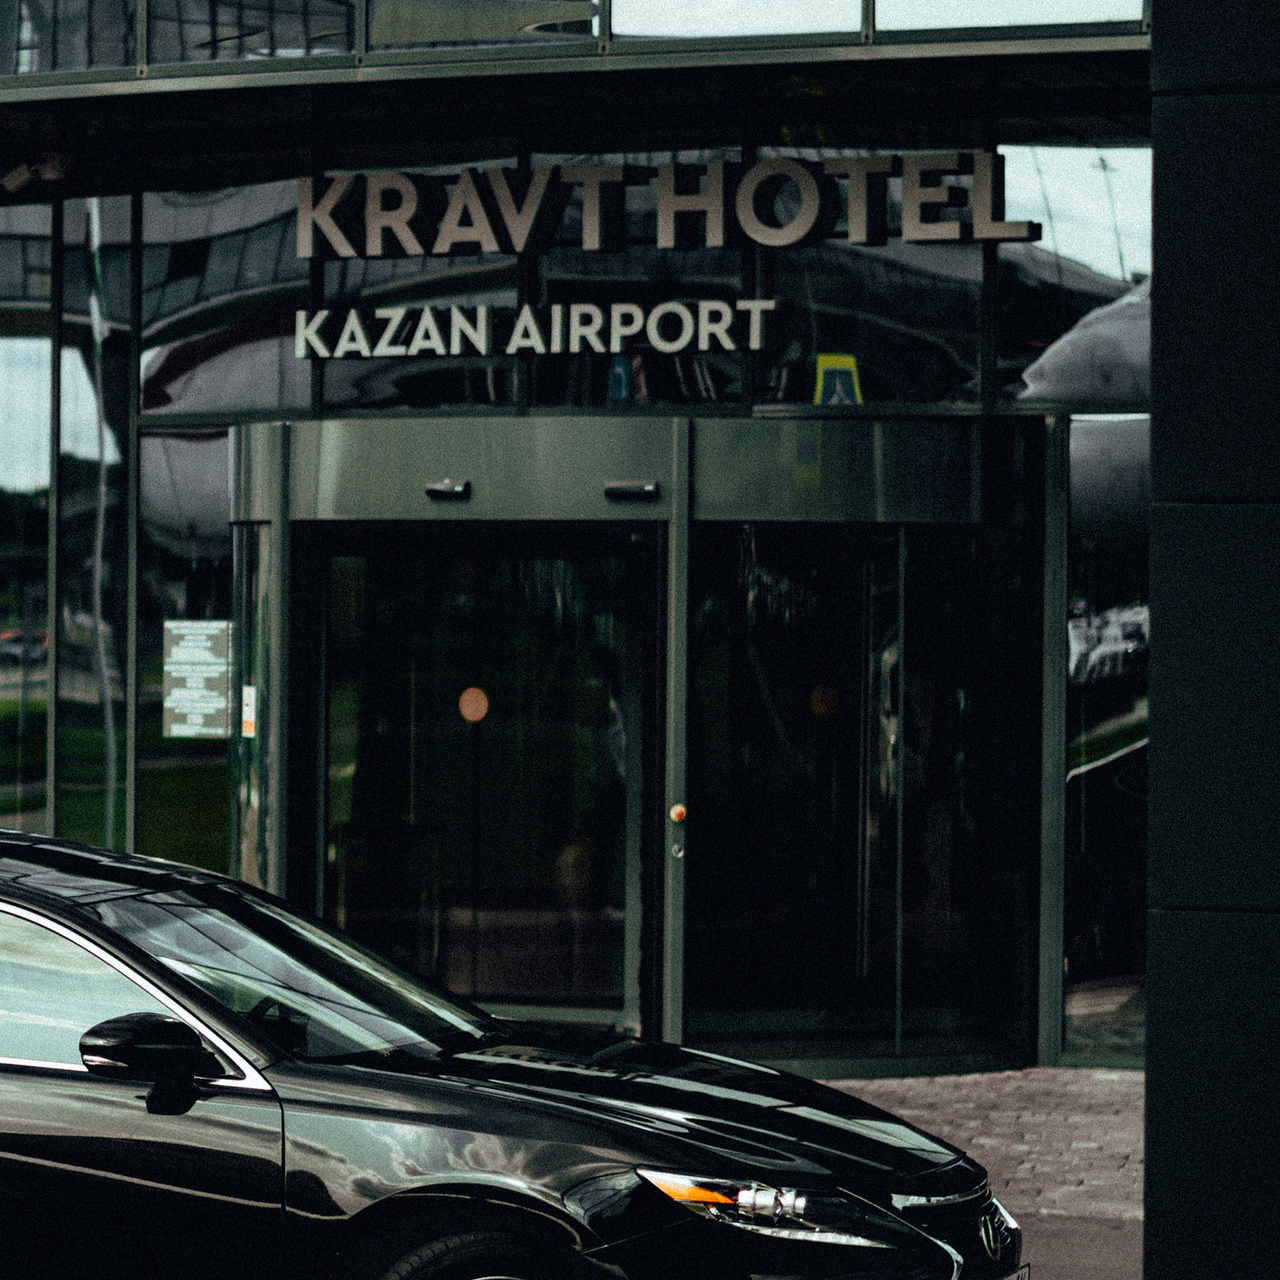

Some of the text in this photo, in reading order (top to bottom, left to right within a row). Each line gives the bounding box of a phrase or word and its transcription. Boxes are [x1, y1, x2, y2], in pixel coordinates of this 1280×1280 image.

[296, 151, 1030, 258] KRAVT HOTEL
[295, 300, 776, 359] KAZAN AIRPORT
